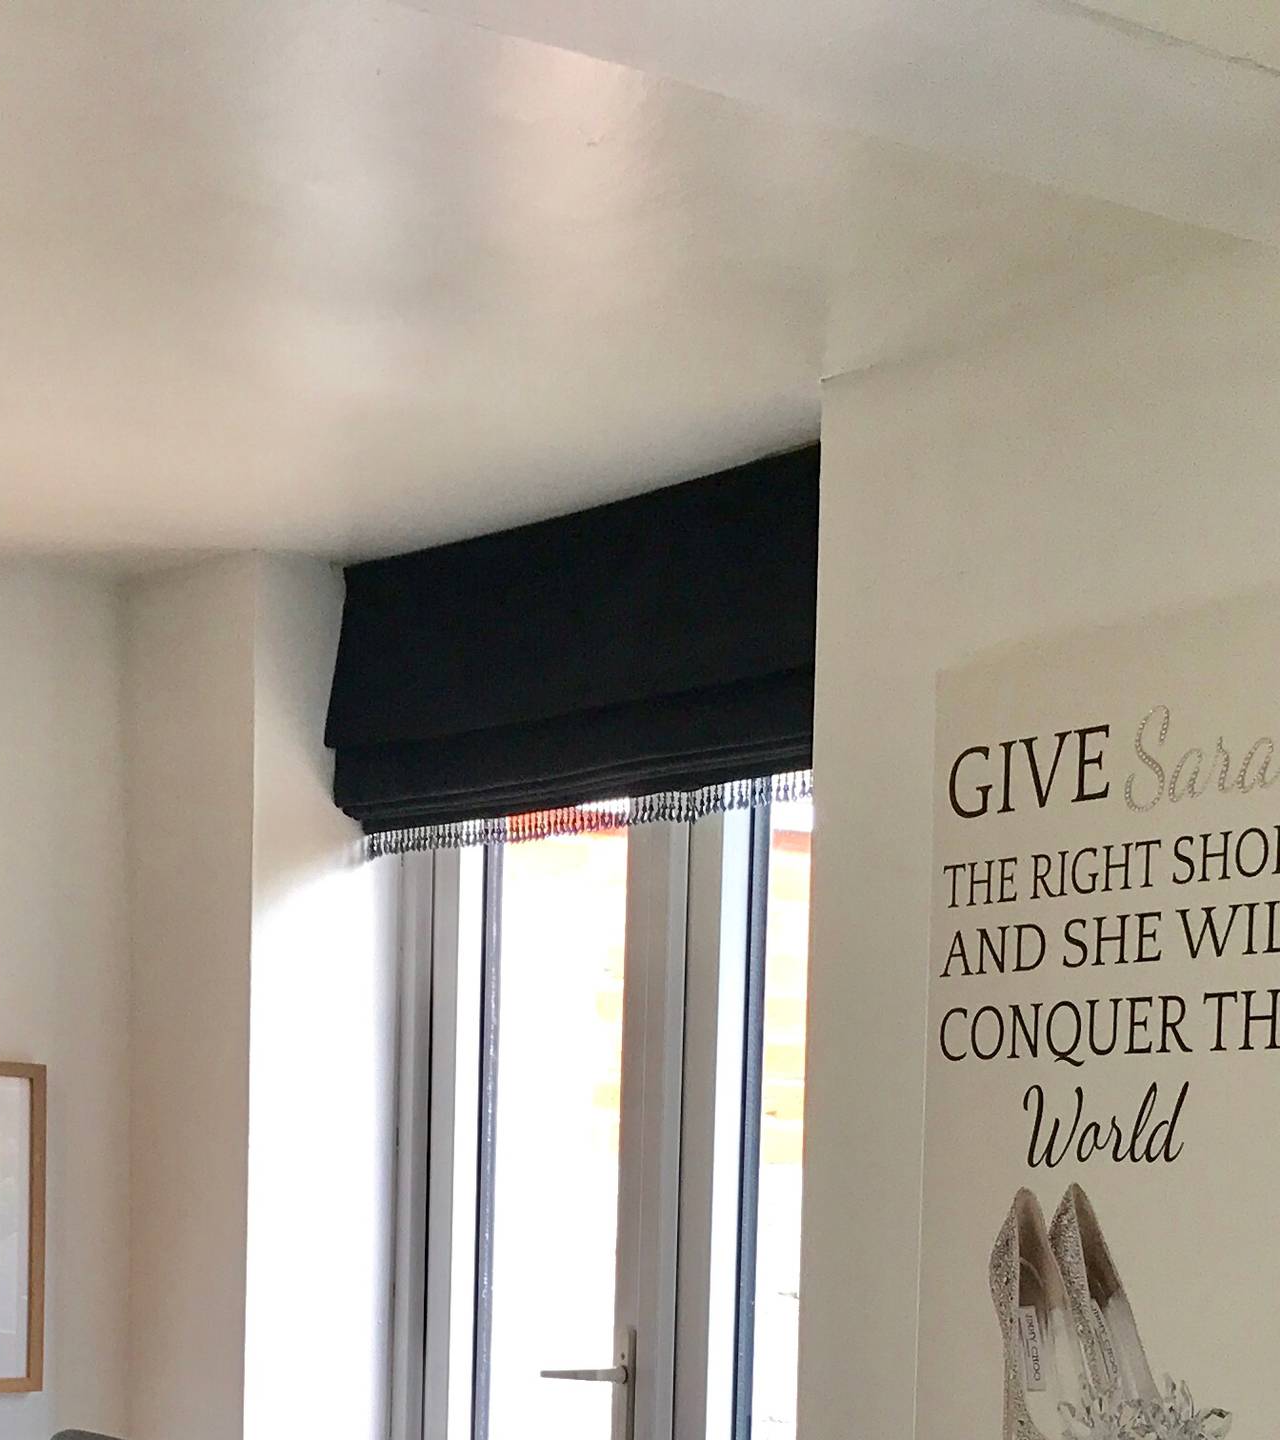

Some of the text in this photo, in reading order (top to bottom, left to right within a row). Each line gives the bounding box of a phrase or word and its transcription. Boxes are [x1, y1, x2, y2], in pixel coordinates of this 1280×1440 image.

[949, 724, 1110, 818] GIVE
[943, 857, 1018, 908] THE
[1030, 839, 1161, 899] RIGHT
[939, 923, 1046, 977] AND
[1062, 911, 1163, 968] SHE
[939, 994, 1193, 1067] CONQUER
[1022, 1081, 1190, 1168] World
